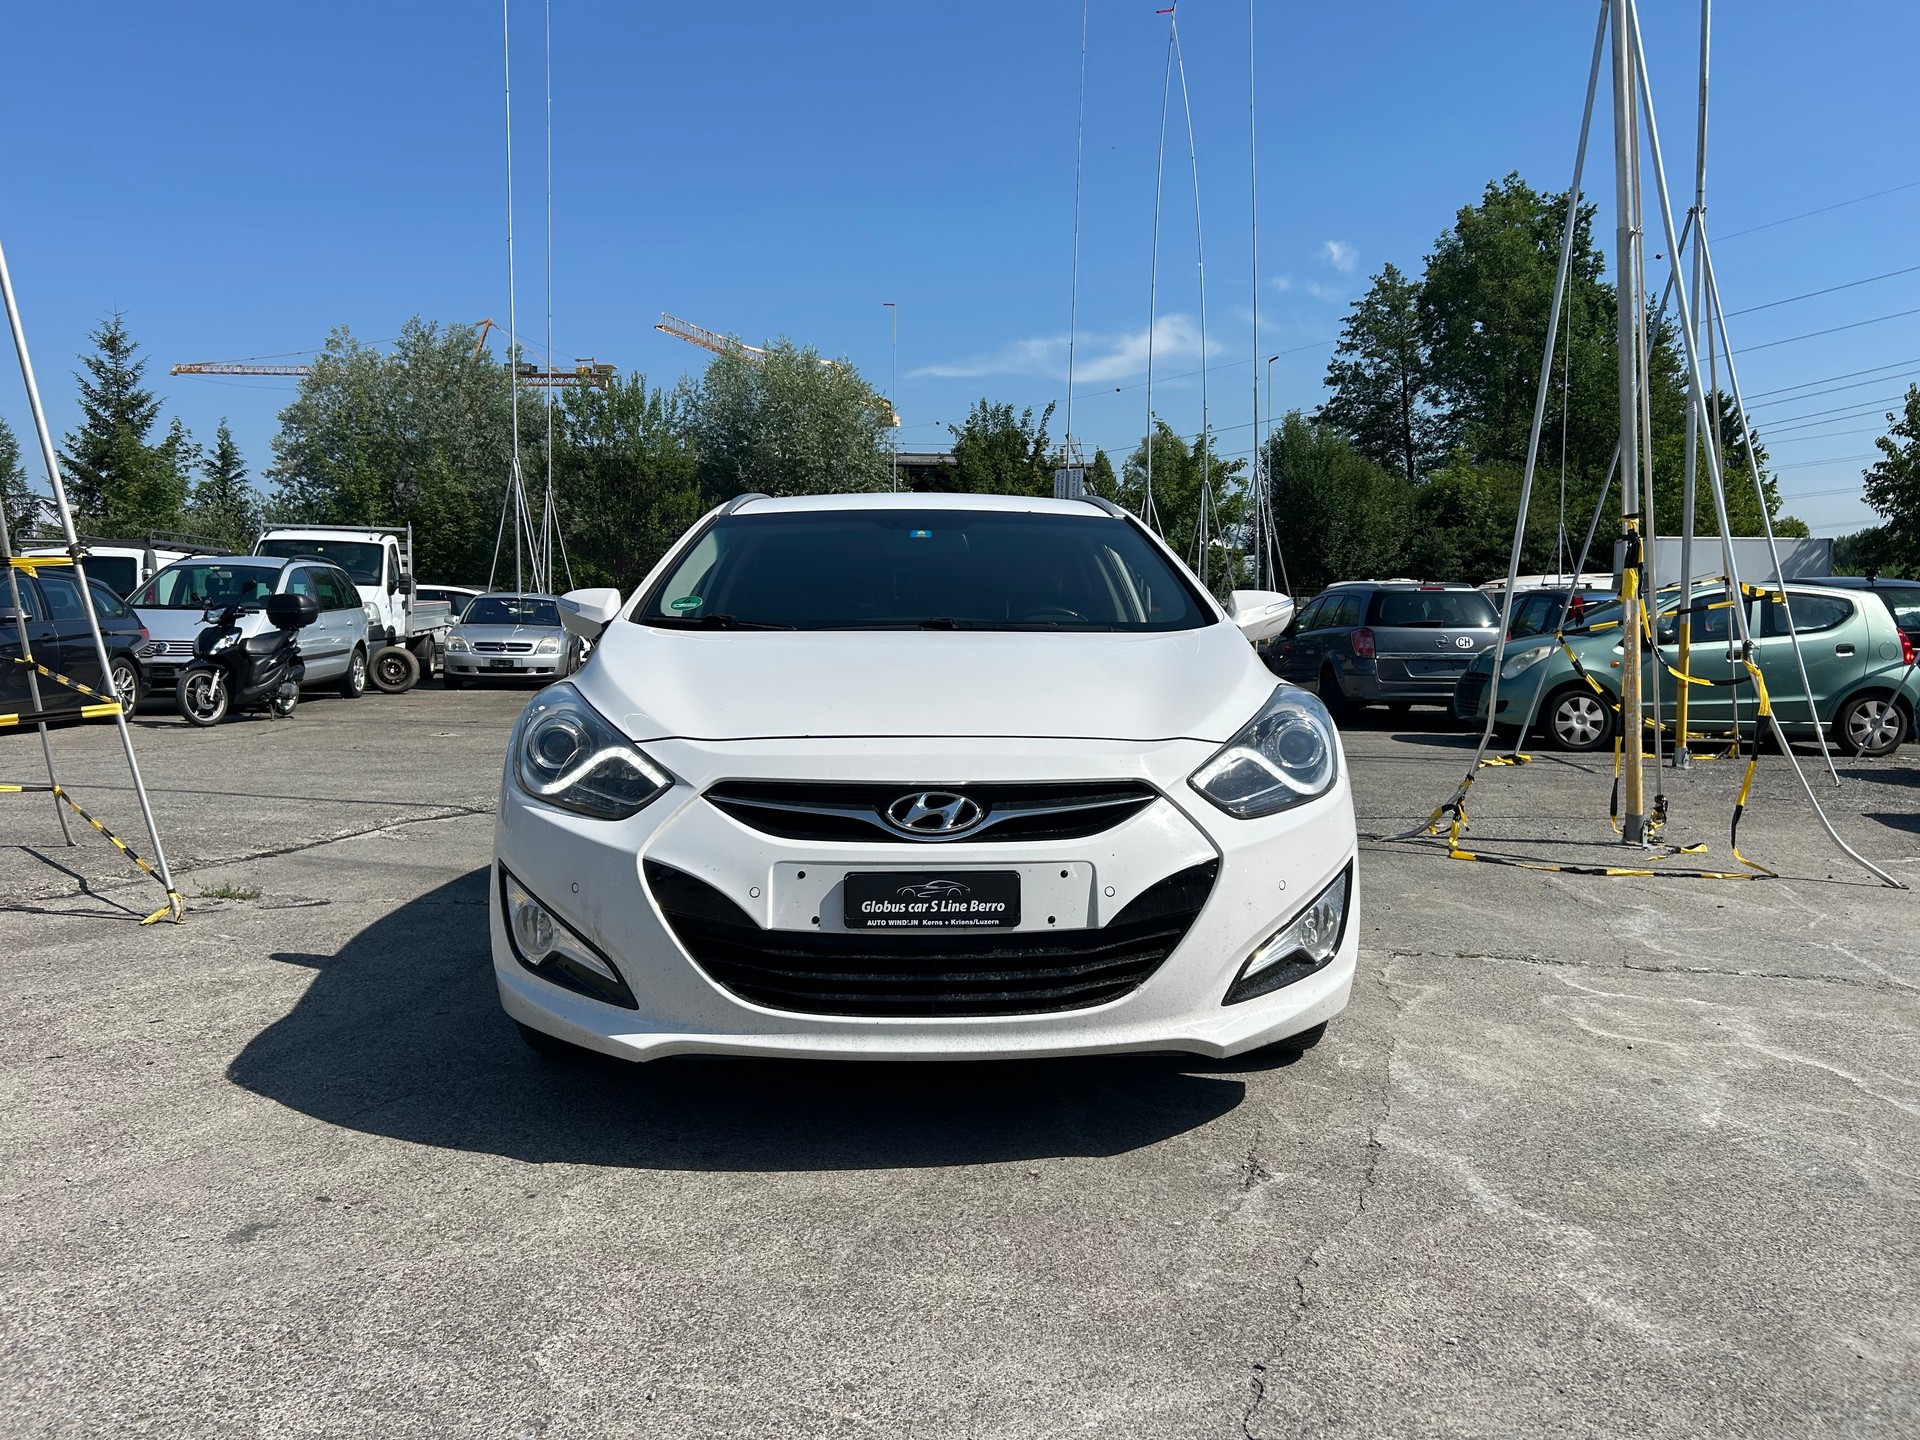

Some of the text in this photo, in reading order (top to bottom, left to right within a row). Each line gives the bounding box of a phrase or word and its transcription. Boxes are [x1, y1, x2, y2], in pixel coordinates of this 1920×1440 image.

[1457, 638, 1471, 647] CH
[861, 900, 1006, 913] Globus car S Line Berro
